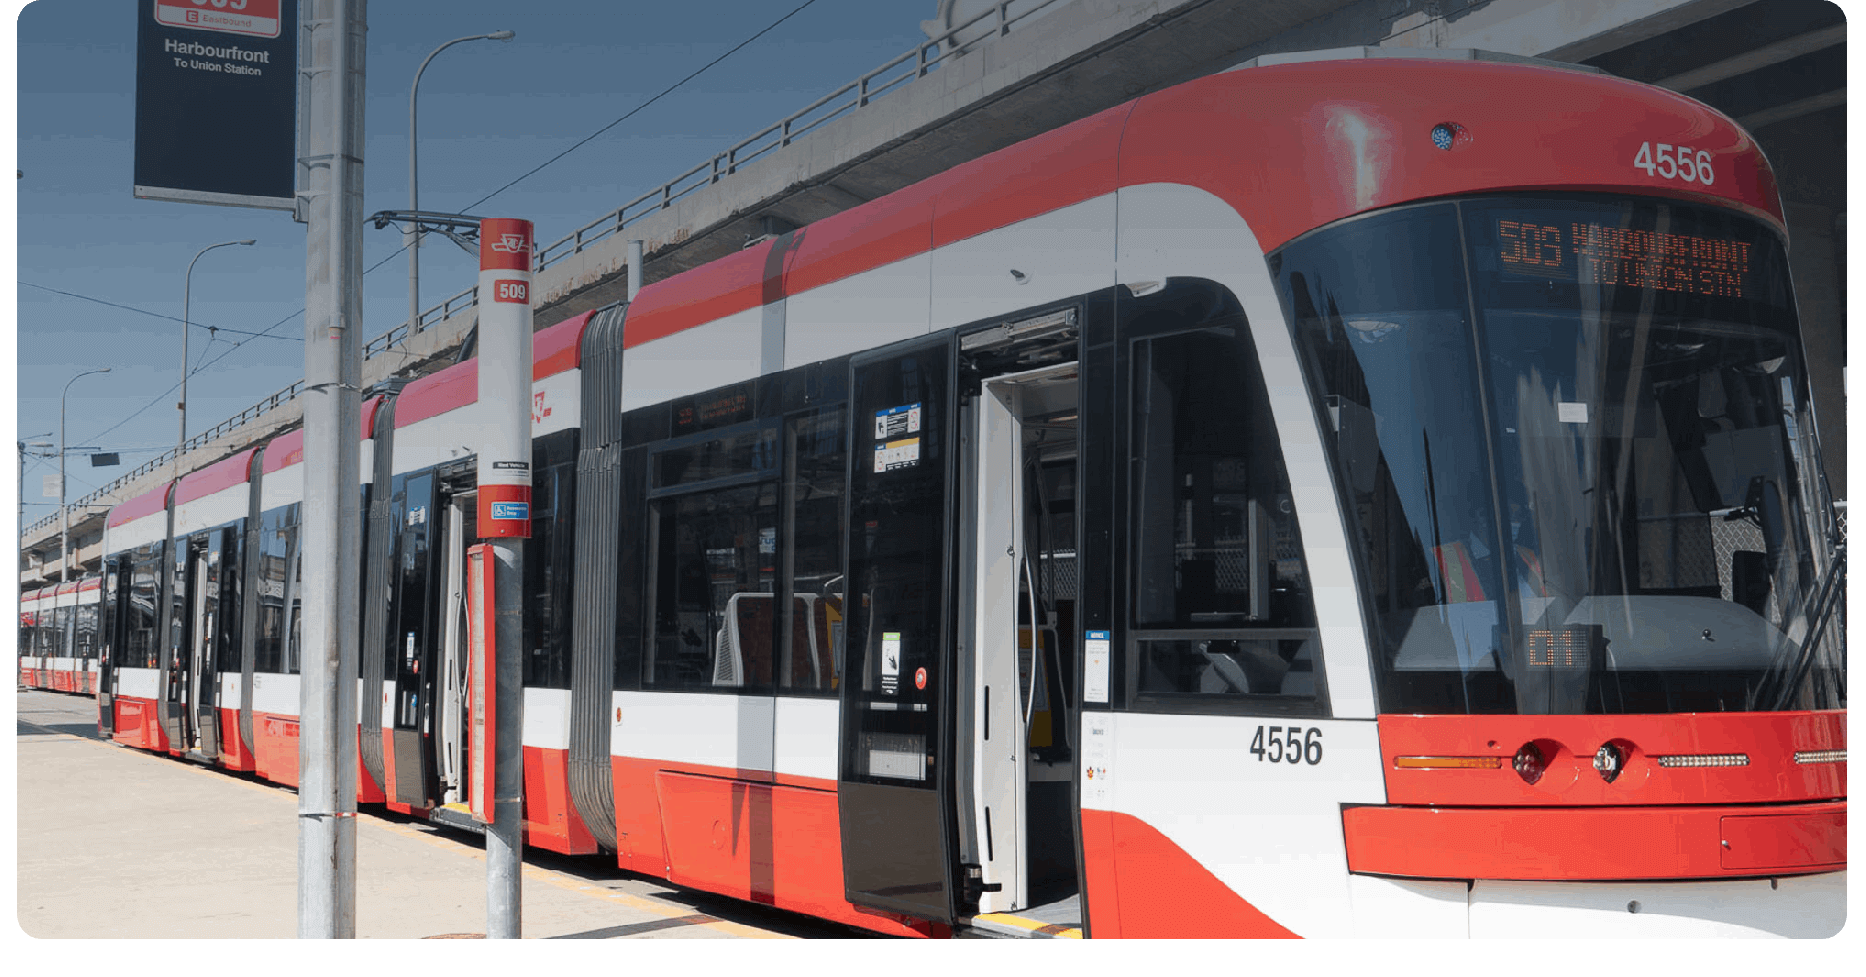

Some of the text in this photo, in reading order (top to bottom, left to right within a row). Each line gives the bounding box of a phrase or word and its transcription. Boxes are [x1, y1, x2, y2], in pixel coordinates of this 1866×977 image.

[203, 14, 252, 28] Eastbound
[164, 38, 270, 64] Harbourfront
[174, 57, 262, 76] To Union Station
[1633, 141, 1715, 186] 4556
[1500, 220, 1561, 267] 509
[1571, 222, 1751, 272] HARBOURFRONT
[500, 283, 526, 299] 509
[1588, 258, 1742, 298] TO UNION STN
[1529, 630, 1572, 666] 01
[1249, 725, 1323, 765] 4556
